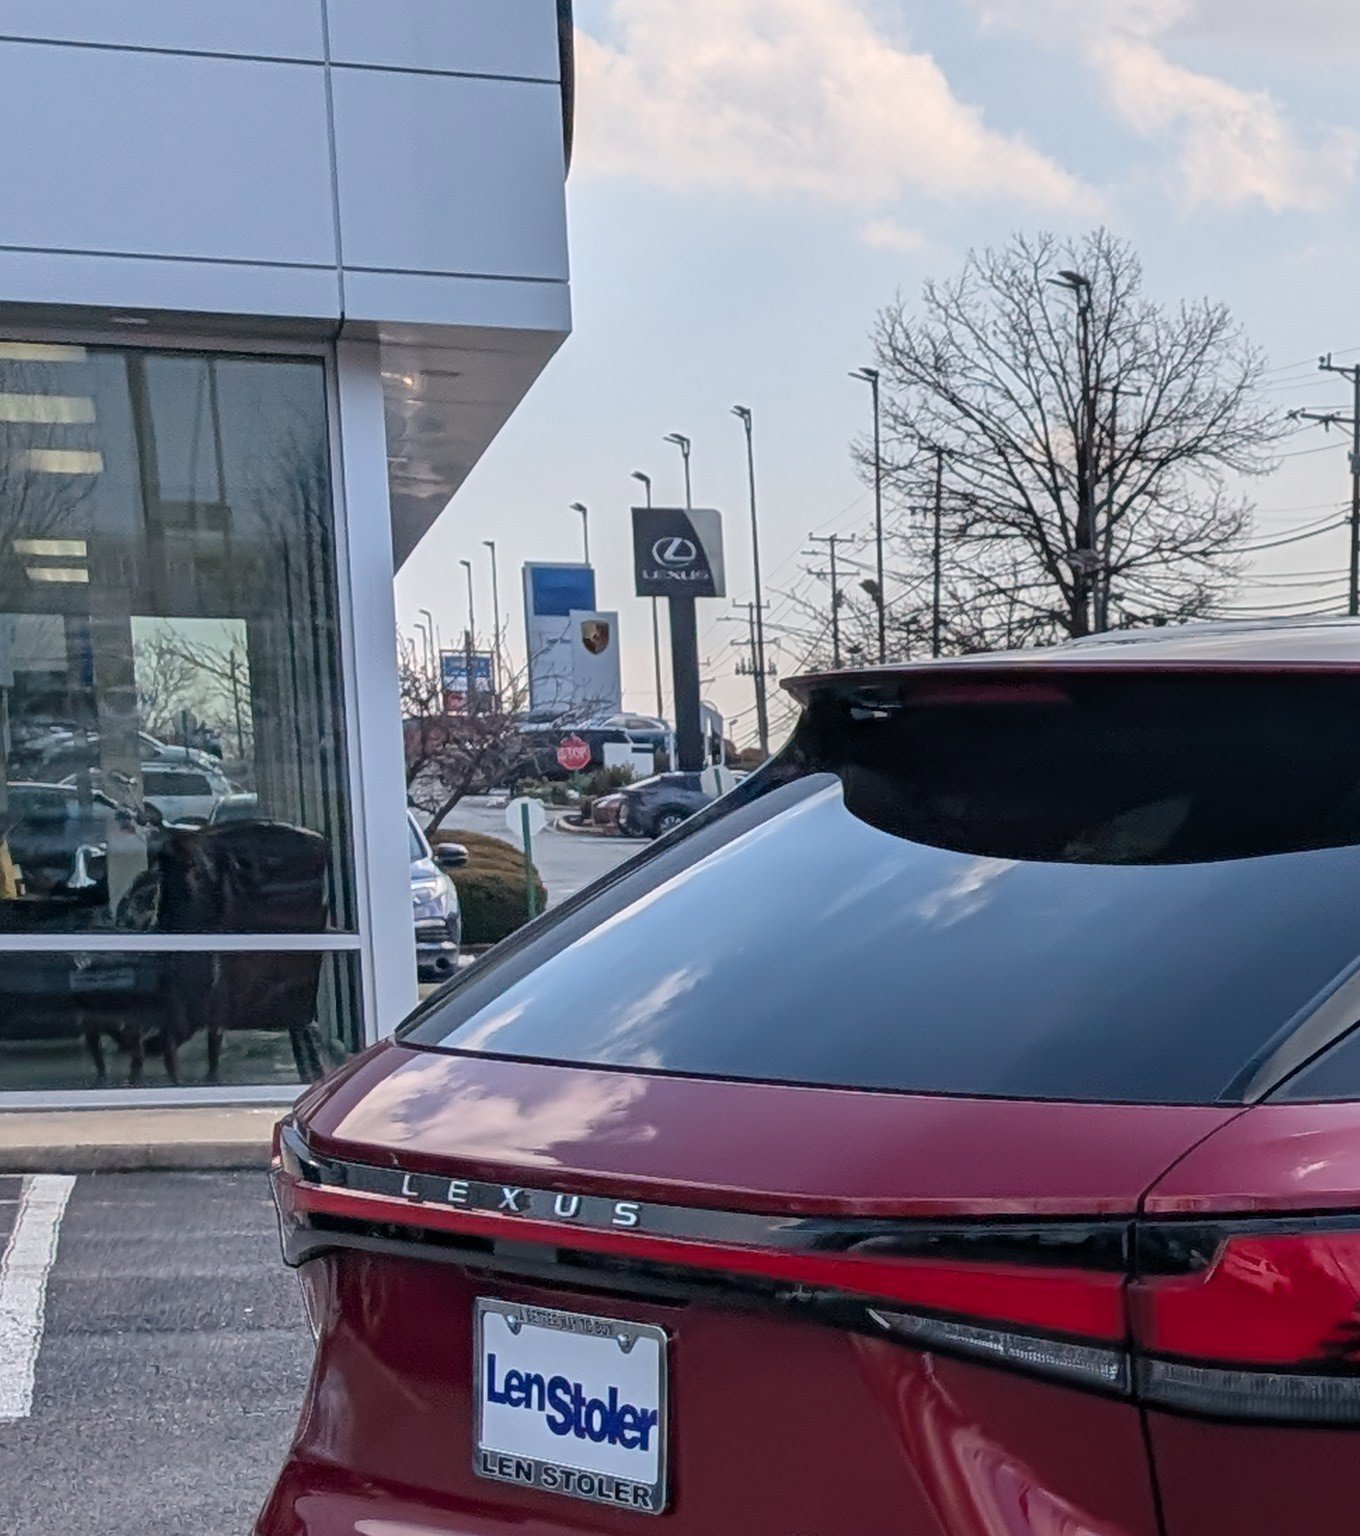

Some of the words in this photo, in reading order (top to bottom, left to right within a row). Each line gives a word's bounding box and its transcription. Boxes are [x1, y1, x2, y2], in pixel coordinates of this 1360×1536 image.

[642, 568, 710, 582] LEXUS
[401, 1173, 640, 1227] LEXUS
[481, 1450, 533, 1482] LEN
[542, 1465, 653, 1509] STOLER
